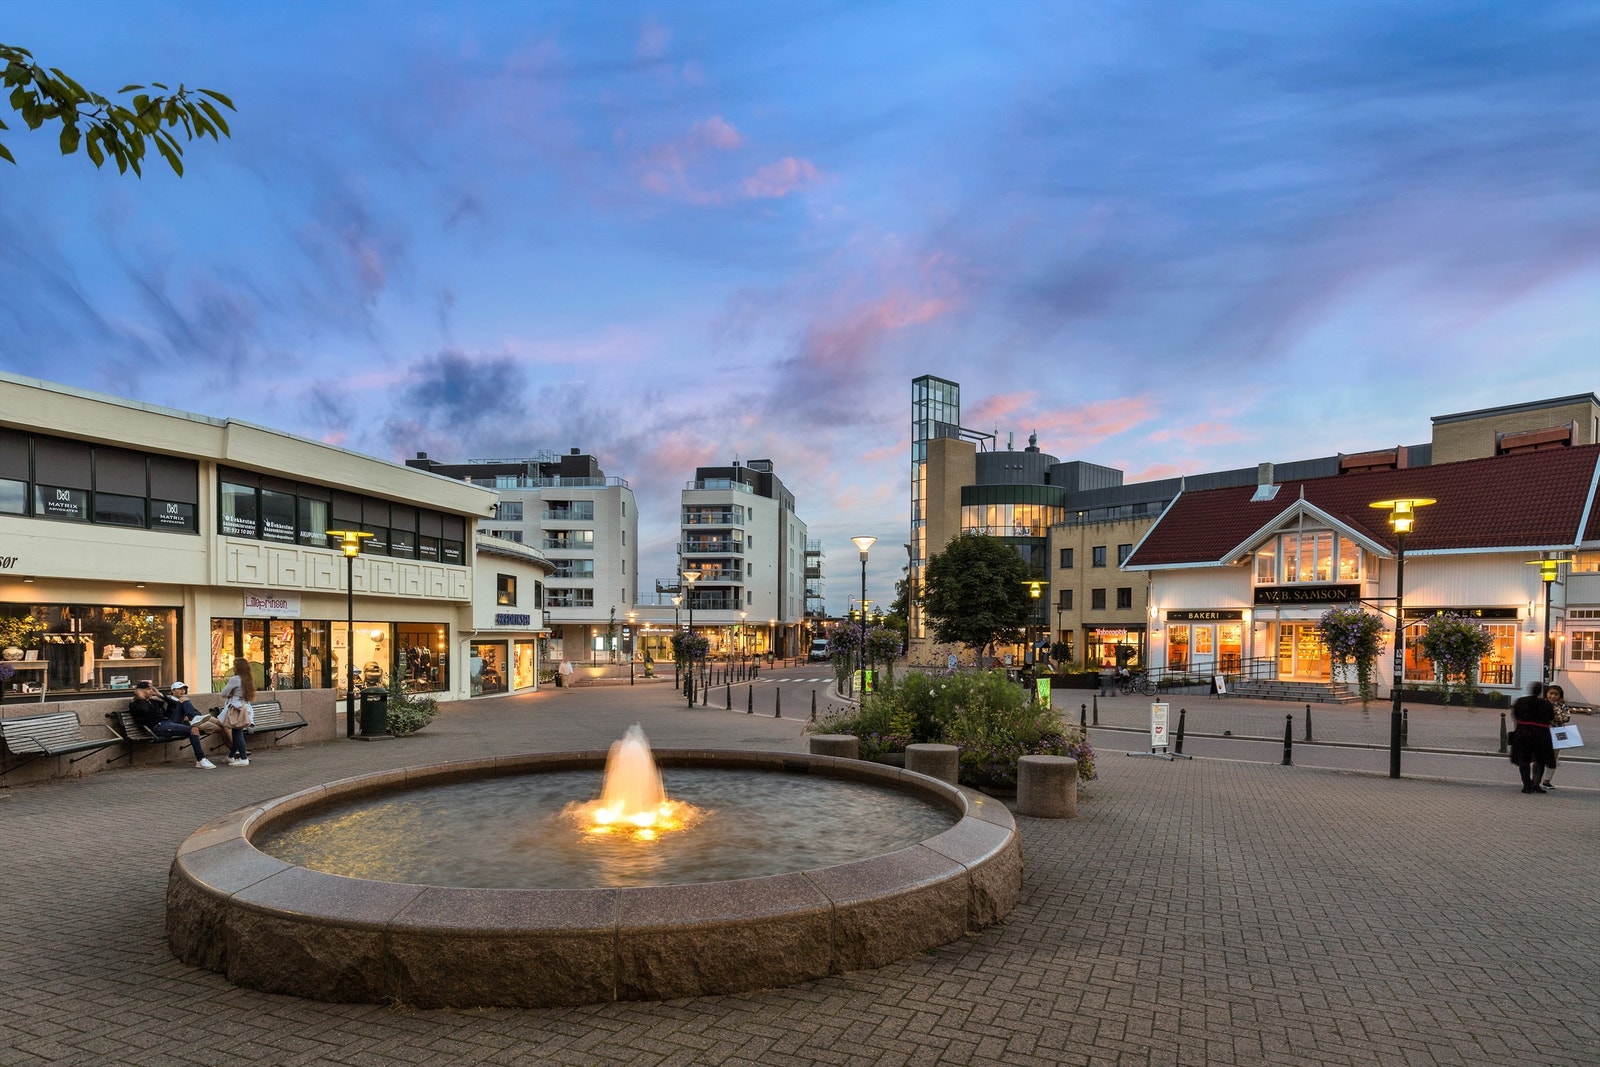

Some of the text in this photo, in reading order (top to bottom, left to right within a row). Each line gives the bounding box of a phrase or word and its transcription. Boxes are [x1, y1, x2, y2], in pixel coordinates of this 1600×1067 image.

[48, 501, 78, 509] MATRIX
[1281, 591, 1292, 600] B.
[1294, 589, 1348, 600] SAMSON
[496, 613, 530, 626] FREDRIKSEN
